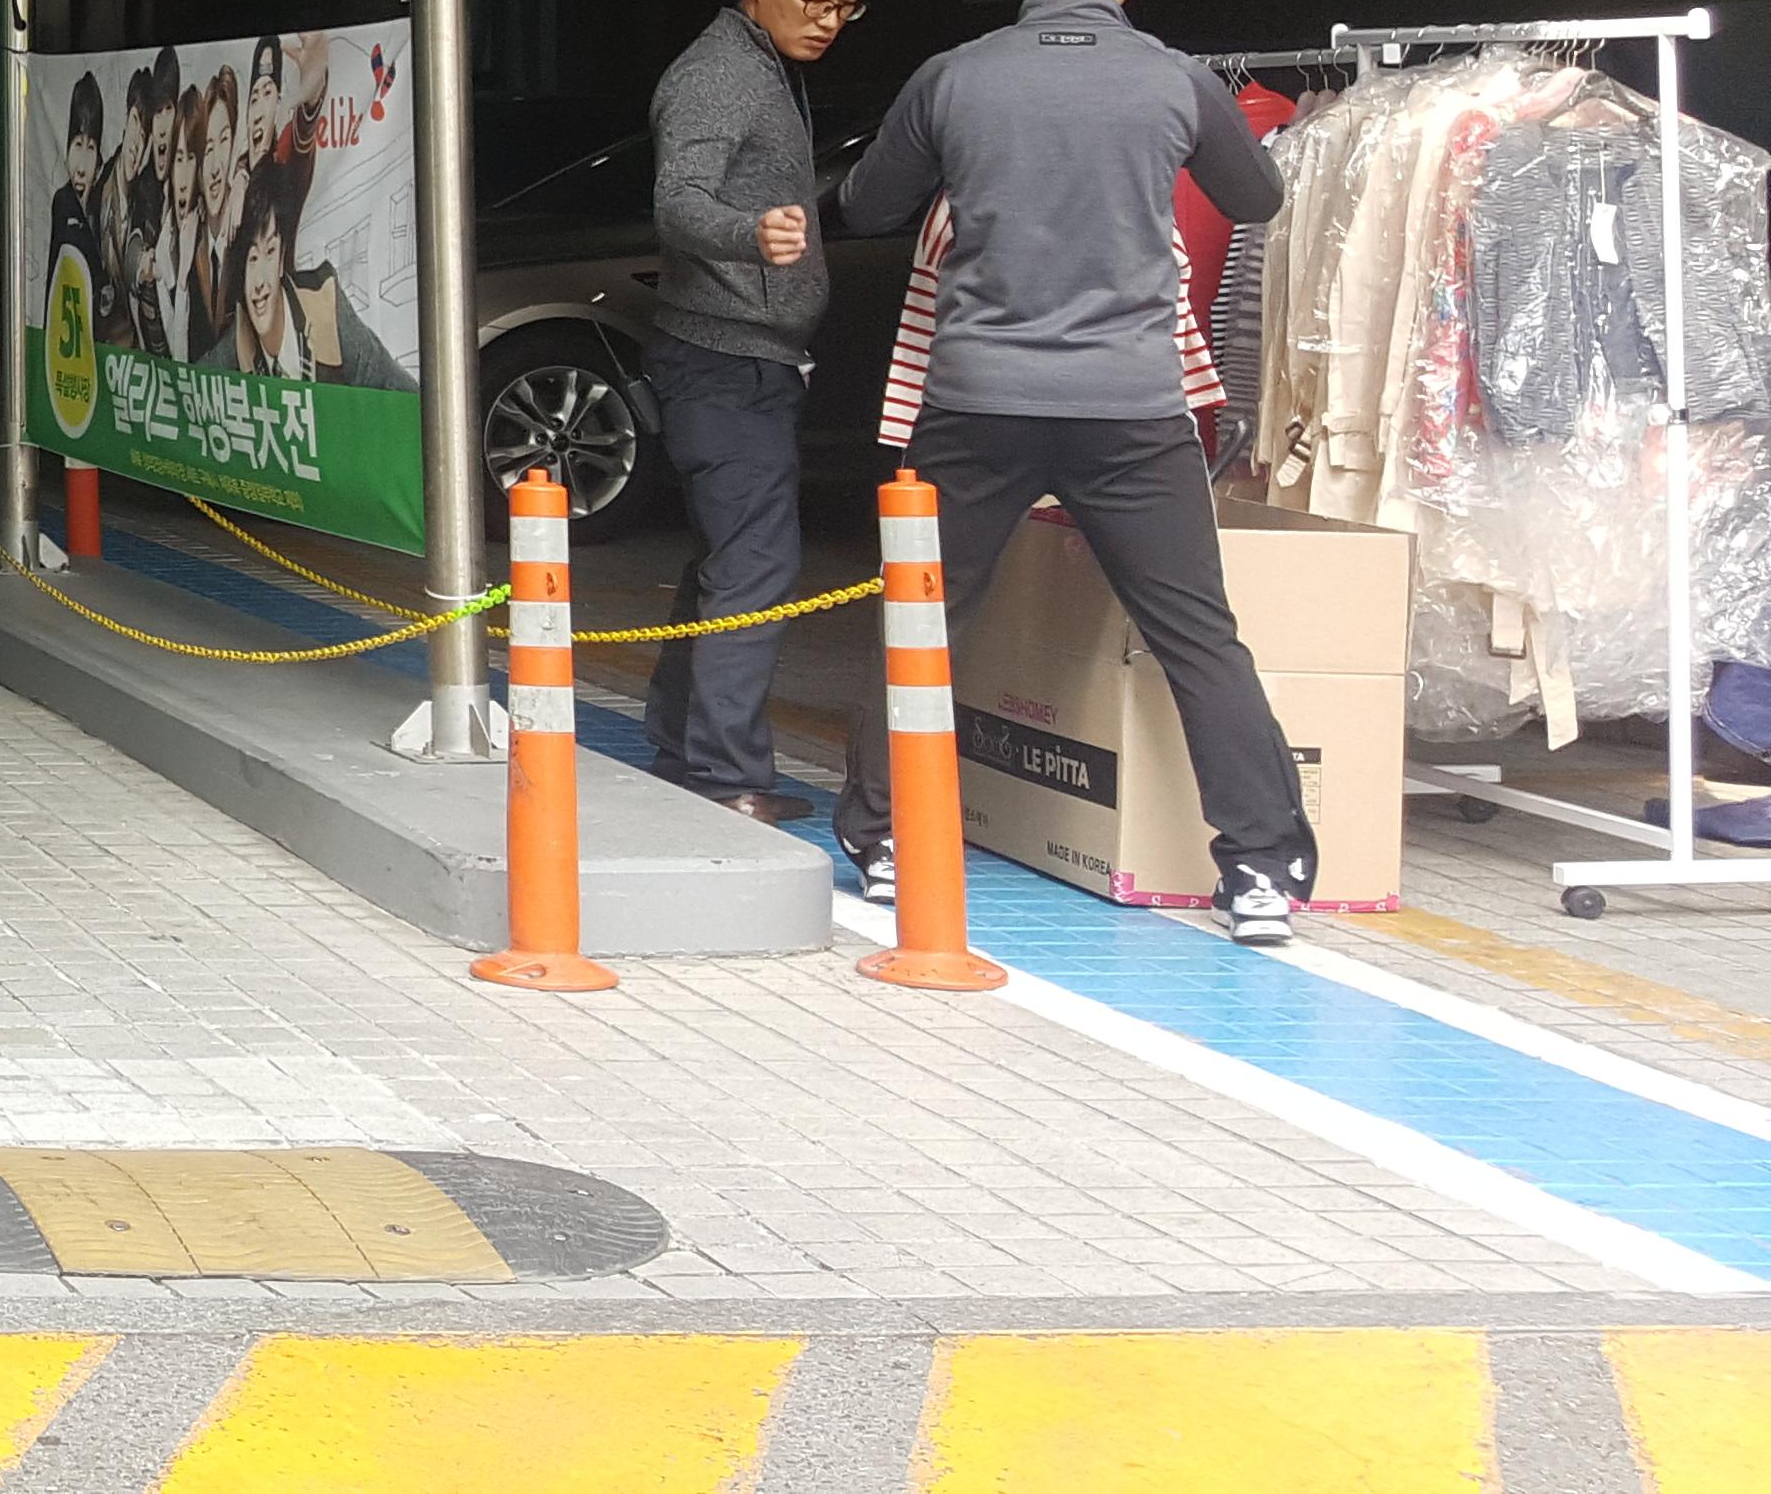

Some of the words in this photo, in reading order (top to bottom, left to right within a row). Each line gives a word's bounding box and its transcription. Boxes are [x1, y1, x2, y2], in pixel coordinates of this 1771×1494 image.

[105, 353, 179, 442] 엘리트
[1023, 745, 1041, 774] LE
[1045, 745, 1090, 790] PITTA
[1046, 840, 1070, 862] MADE
[1072, 850, 1081, 866] IN
[1082, 854, 1111, 878] KOREA
